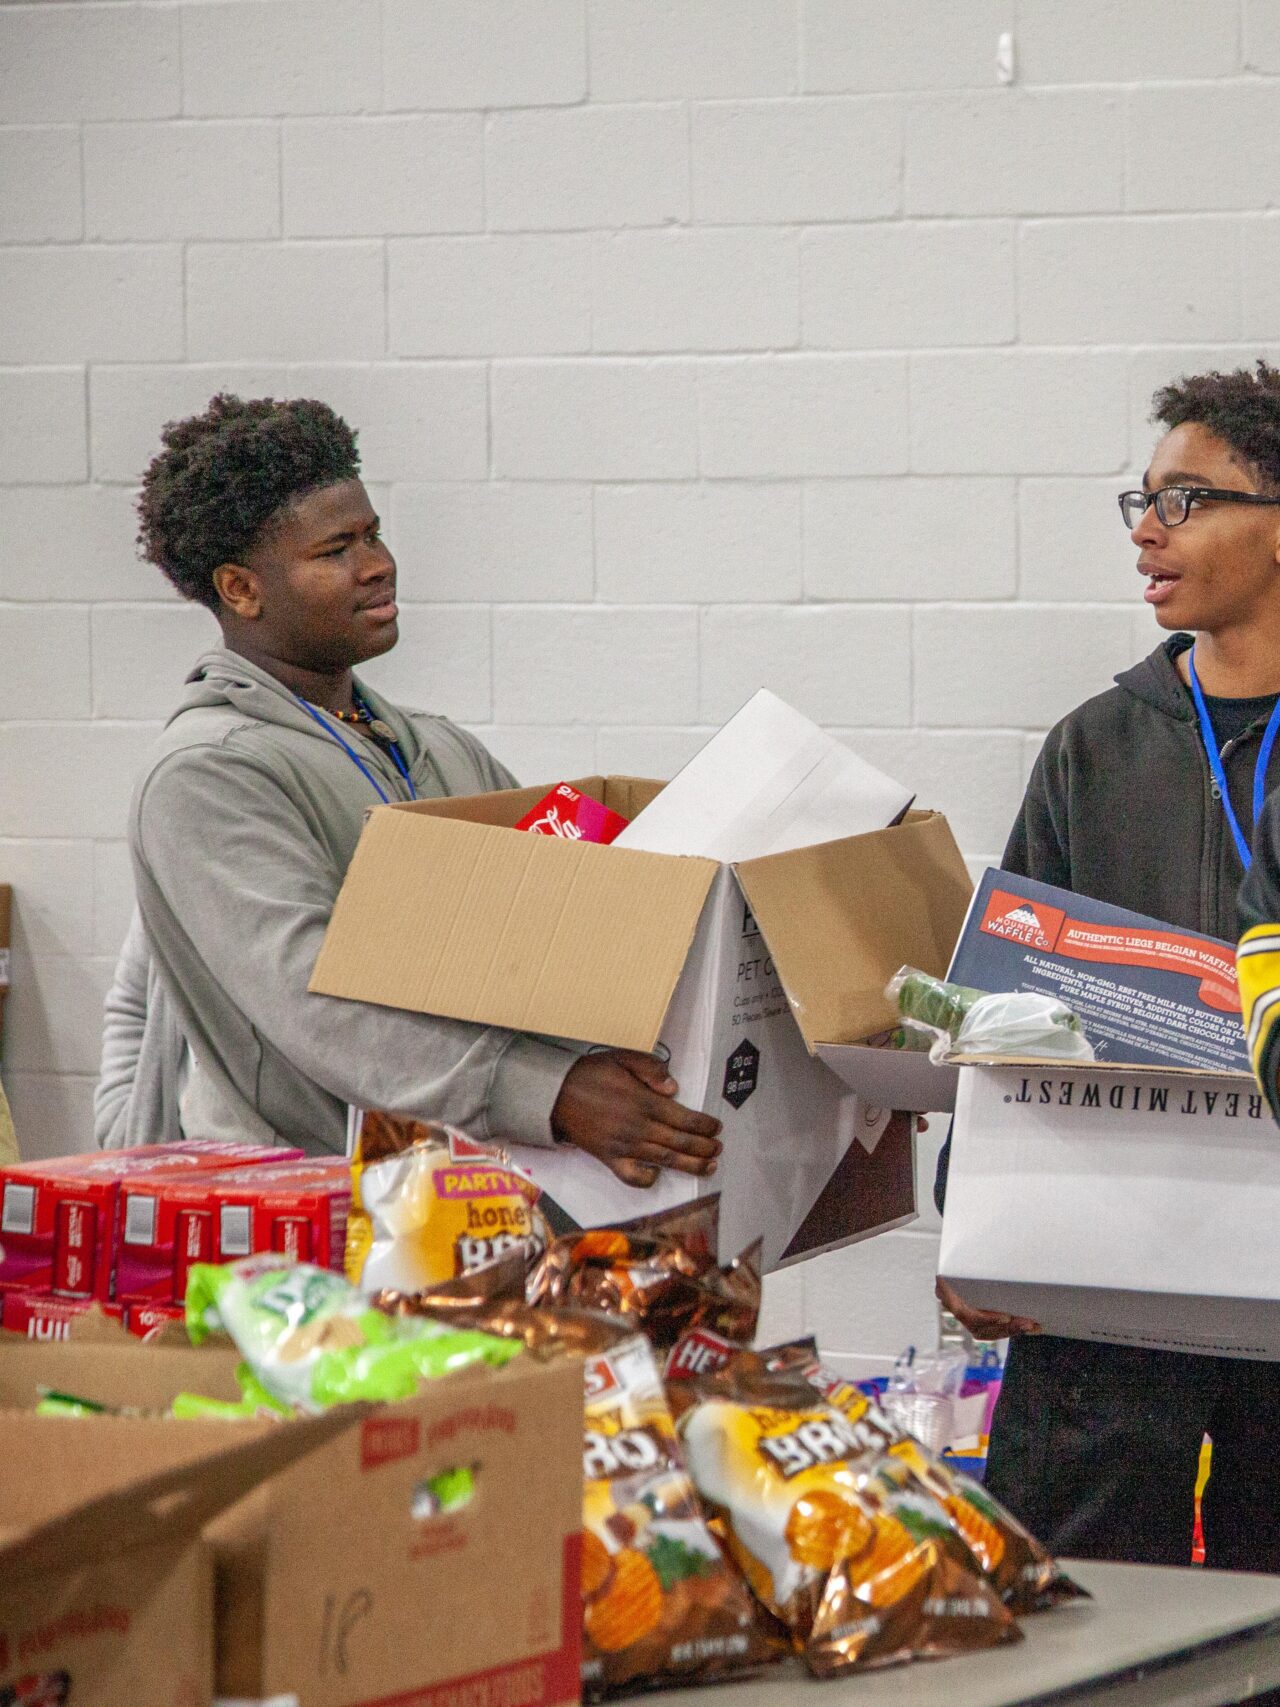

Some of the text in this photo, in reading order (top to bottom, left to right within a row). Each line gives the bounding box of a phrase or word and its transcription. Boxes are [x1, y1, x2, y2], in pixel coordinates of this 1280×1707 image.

[987, 920, 1033, 943] WAFFLE
[995, 916, 1044, 936] MOUNTAIN
[1067, 929, 1124, 945] AUTHENTIC
[1125, 937, 1154, 948] LIEGE
[1155, 941, 1197, 958] BELGIAN
[1199, 951, 1238, 979] WAFFLES
[737, 959, 761, 983] PET
[1023, 954, 1039, 965] ALL
[1038, 958, 1077, 978] NATURAL,
[1076, 971, 1118, 991] NON-GMO,
[1136, 990, 1156, 1002] FREE
[1156, 997, 1176, 1009] MILK
[1176, 1003, 1194, 1015] AND
[1193, 1009, 1226, 1026] BUTTER,
[1226, 1019, 1239, 1029] NO
[1031, 965, 1085, 988] INGREDIENTS,
[1084, 982, 1145, 1008] PRESERVATIVES,
[1145, 1002, 1188, 1022] ADDITIVES,
[1188, 1016, 1219, 1031] COLORS
[1219, 1026, 1232, 1035] OR
[1059, 983, 1235, 1045] PURE MAPLE SYRUP, BELGIAN DARK CHOCOLATE
[732, 1056, 743, 1069] 20
[1181, 1089, 1264, 1119] REAT
[443, 1170, 513, 1194] PARTY
